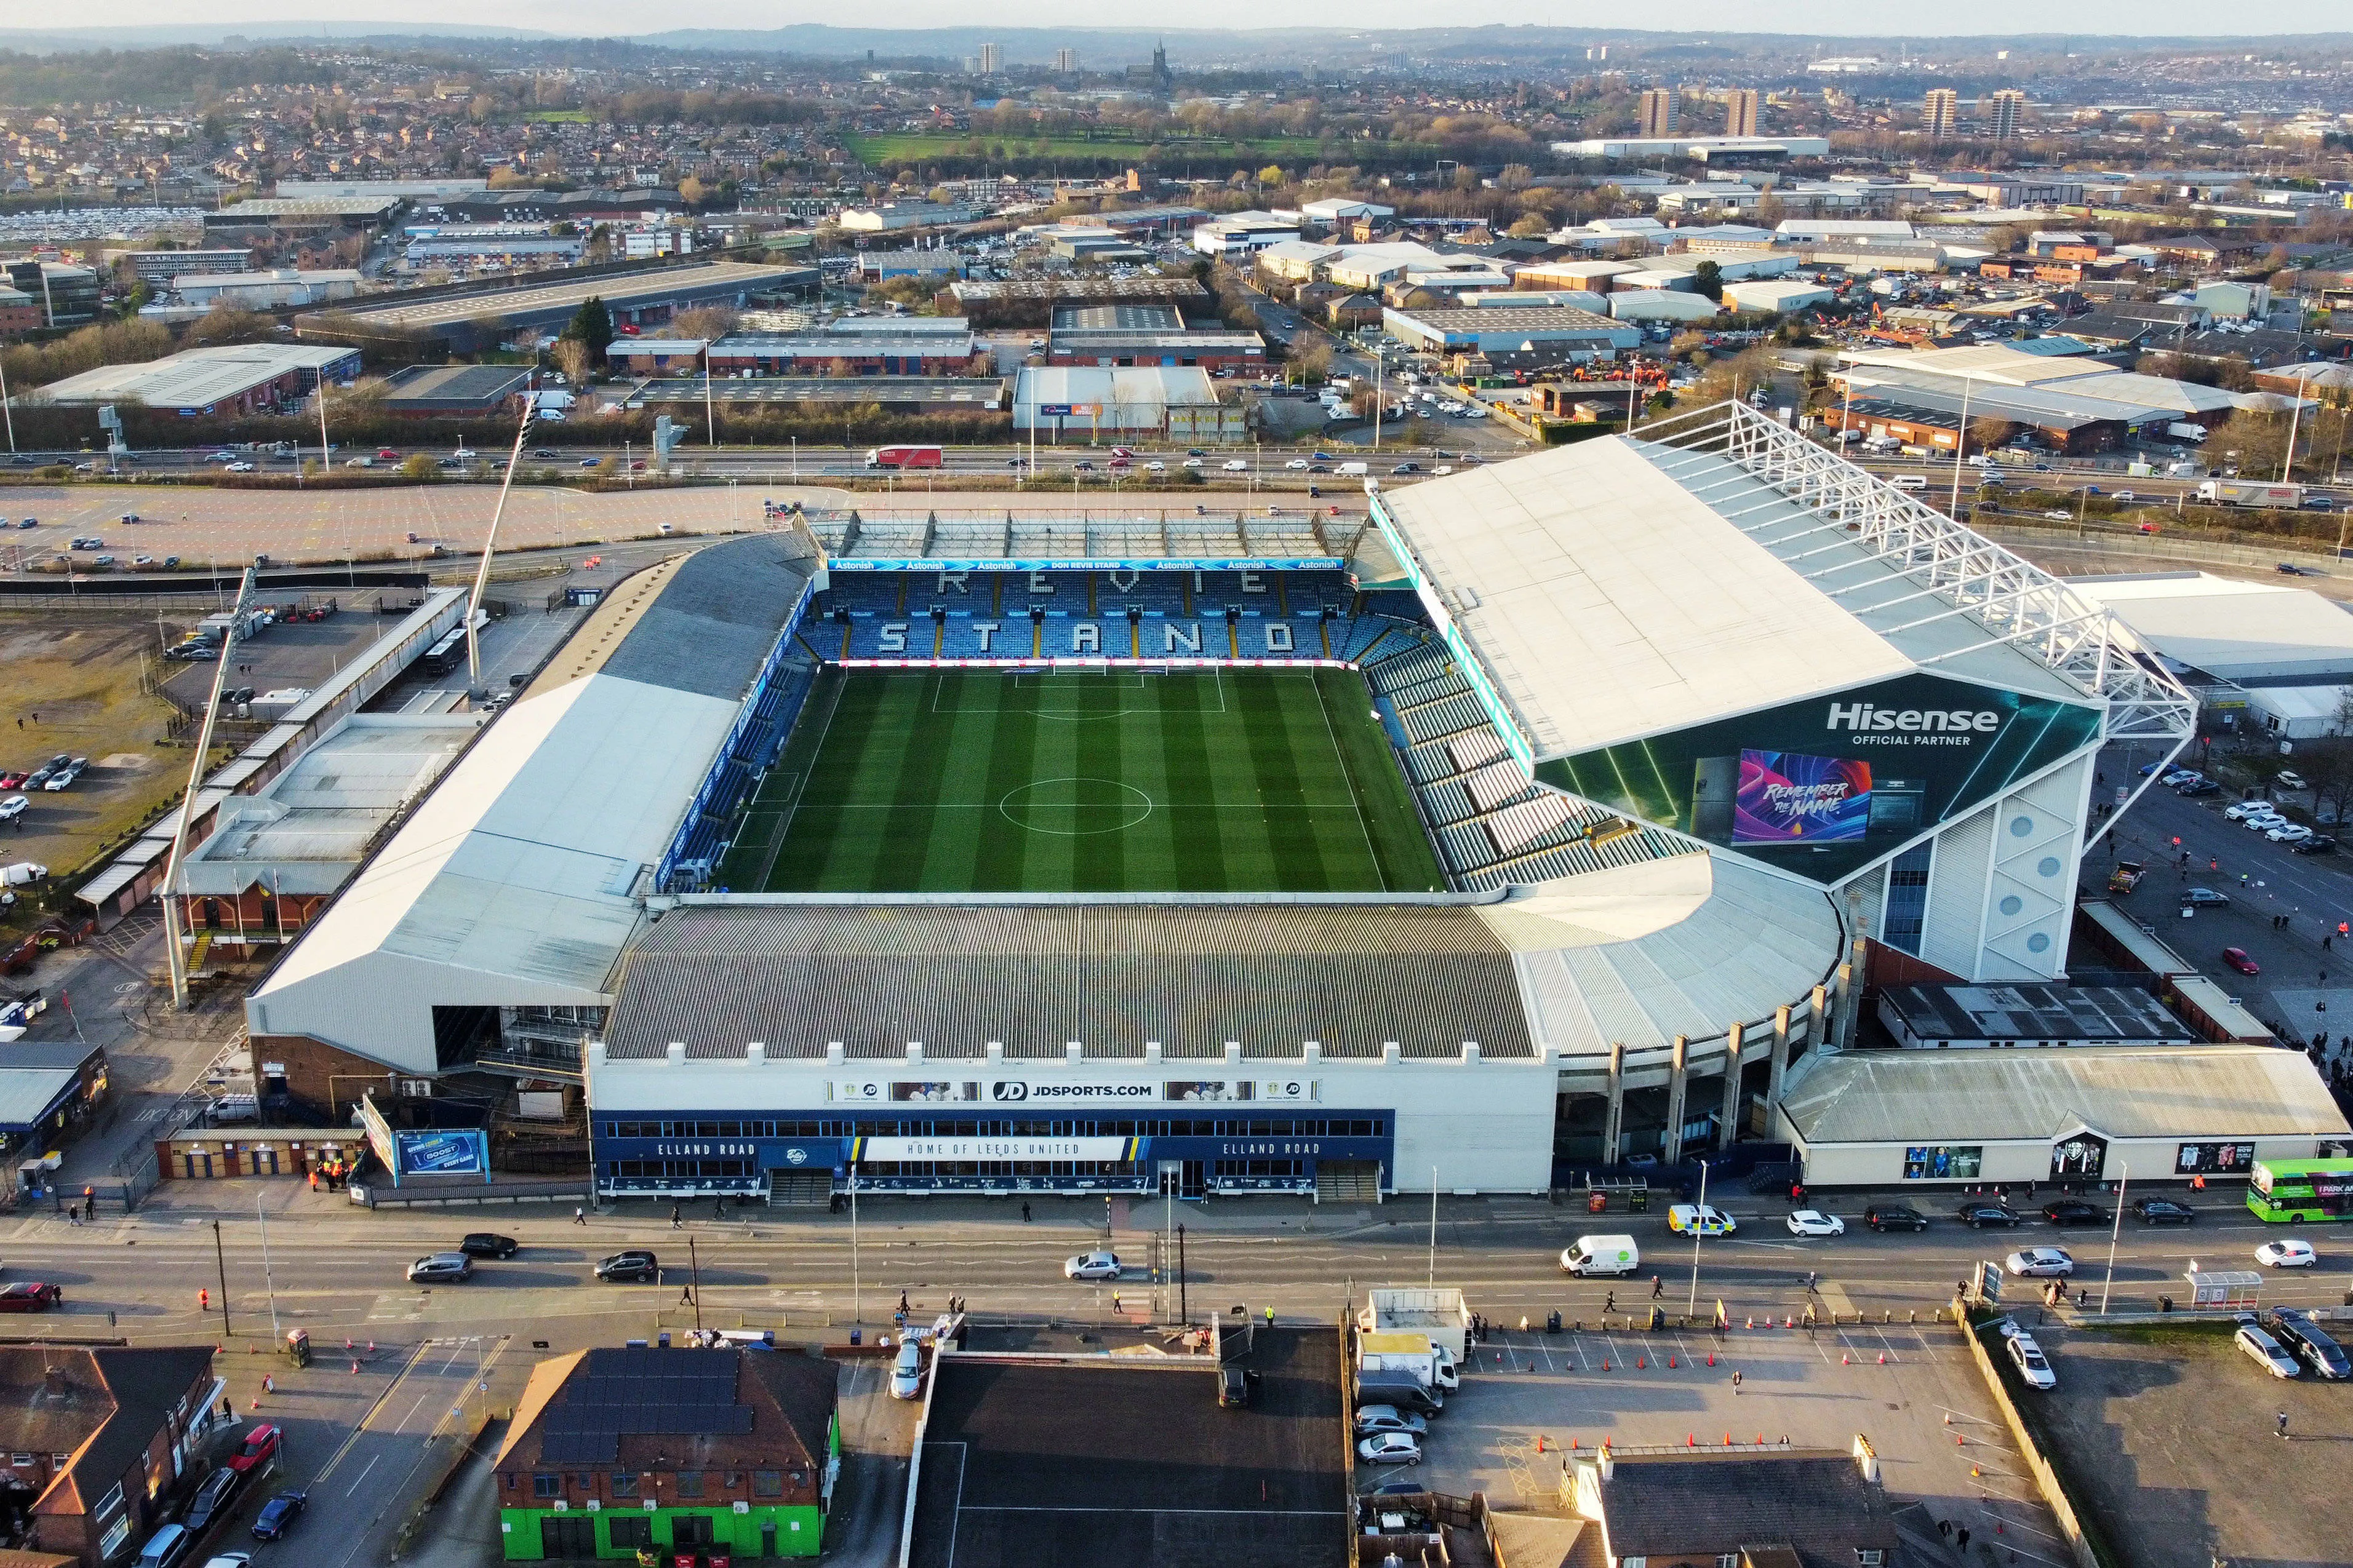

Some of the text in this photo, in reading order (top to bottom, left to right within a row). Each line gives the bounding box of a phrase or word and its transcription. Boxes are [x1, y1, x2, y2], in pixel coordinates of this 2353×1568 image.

[836, 561, 874, 570] Astonish
[906, 561, 945, 570] Astonish
[977, 561, 1017, 570] Astonish
[1156, 561, 1195, 570] Astonish
[1227, 561, 1266, 570] Astonish
[1298, 560, 1337, 570] Astonish
[1827, 702, 1999, 732] Hisense
[1852, 735, 1971, 746] OFFICIAL PARTNER
[1763, 782, 1849, 802] REMEMBER
[1775, 802, 1791, 813] THE
[997, 1083, 1152, 1100] JD JDSPORTS.COM
[426, 1145, 457, 1160] BOOST
[658, 1144, 755, 1155] ELLAND ROAD
[908, 1144, 1079, 1154] HOME OF LEEDS UNITED
[1223, 1144, 1319, 1154] ELLAND ROAD
